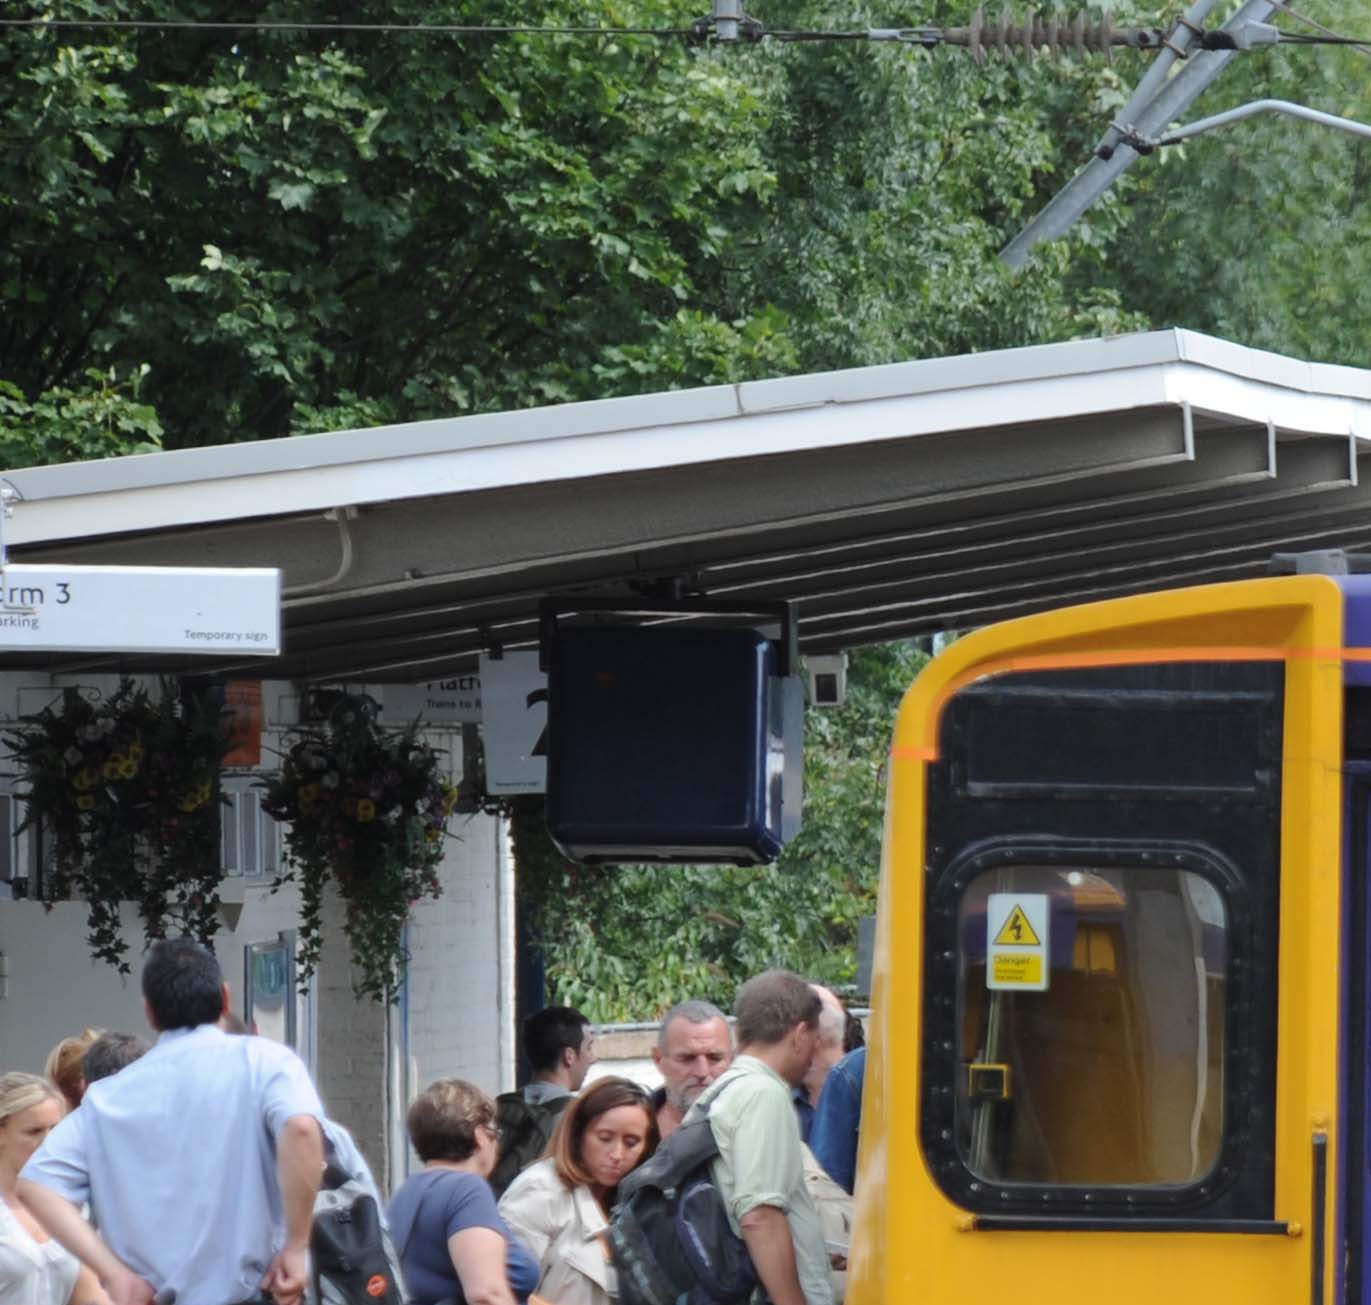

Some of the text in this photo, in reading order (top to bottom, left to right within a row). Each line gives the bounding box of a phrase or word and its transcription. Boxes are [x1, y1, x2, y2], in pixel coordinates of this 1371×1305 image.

[55, 583, 71, 605] 3
[184, 629, 269, 642] Temporary sign
